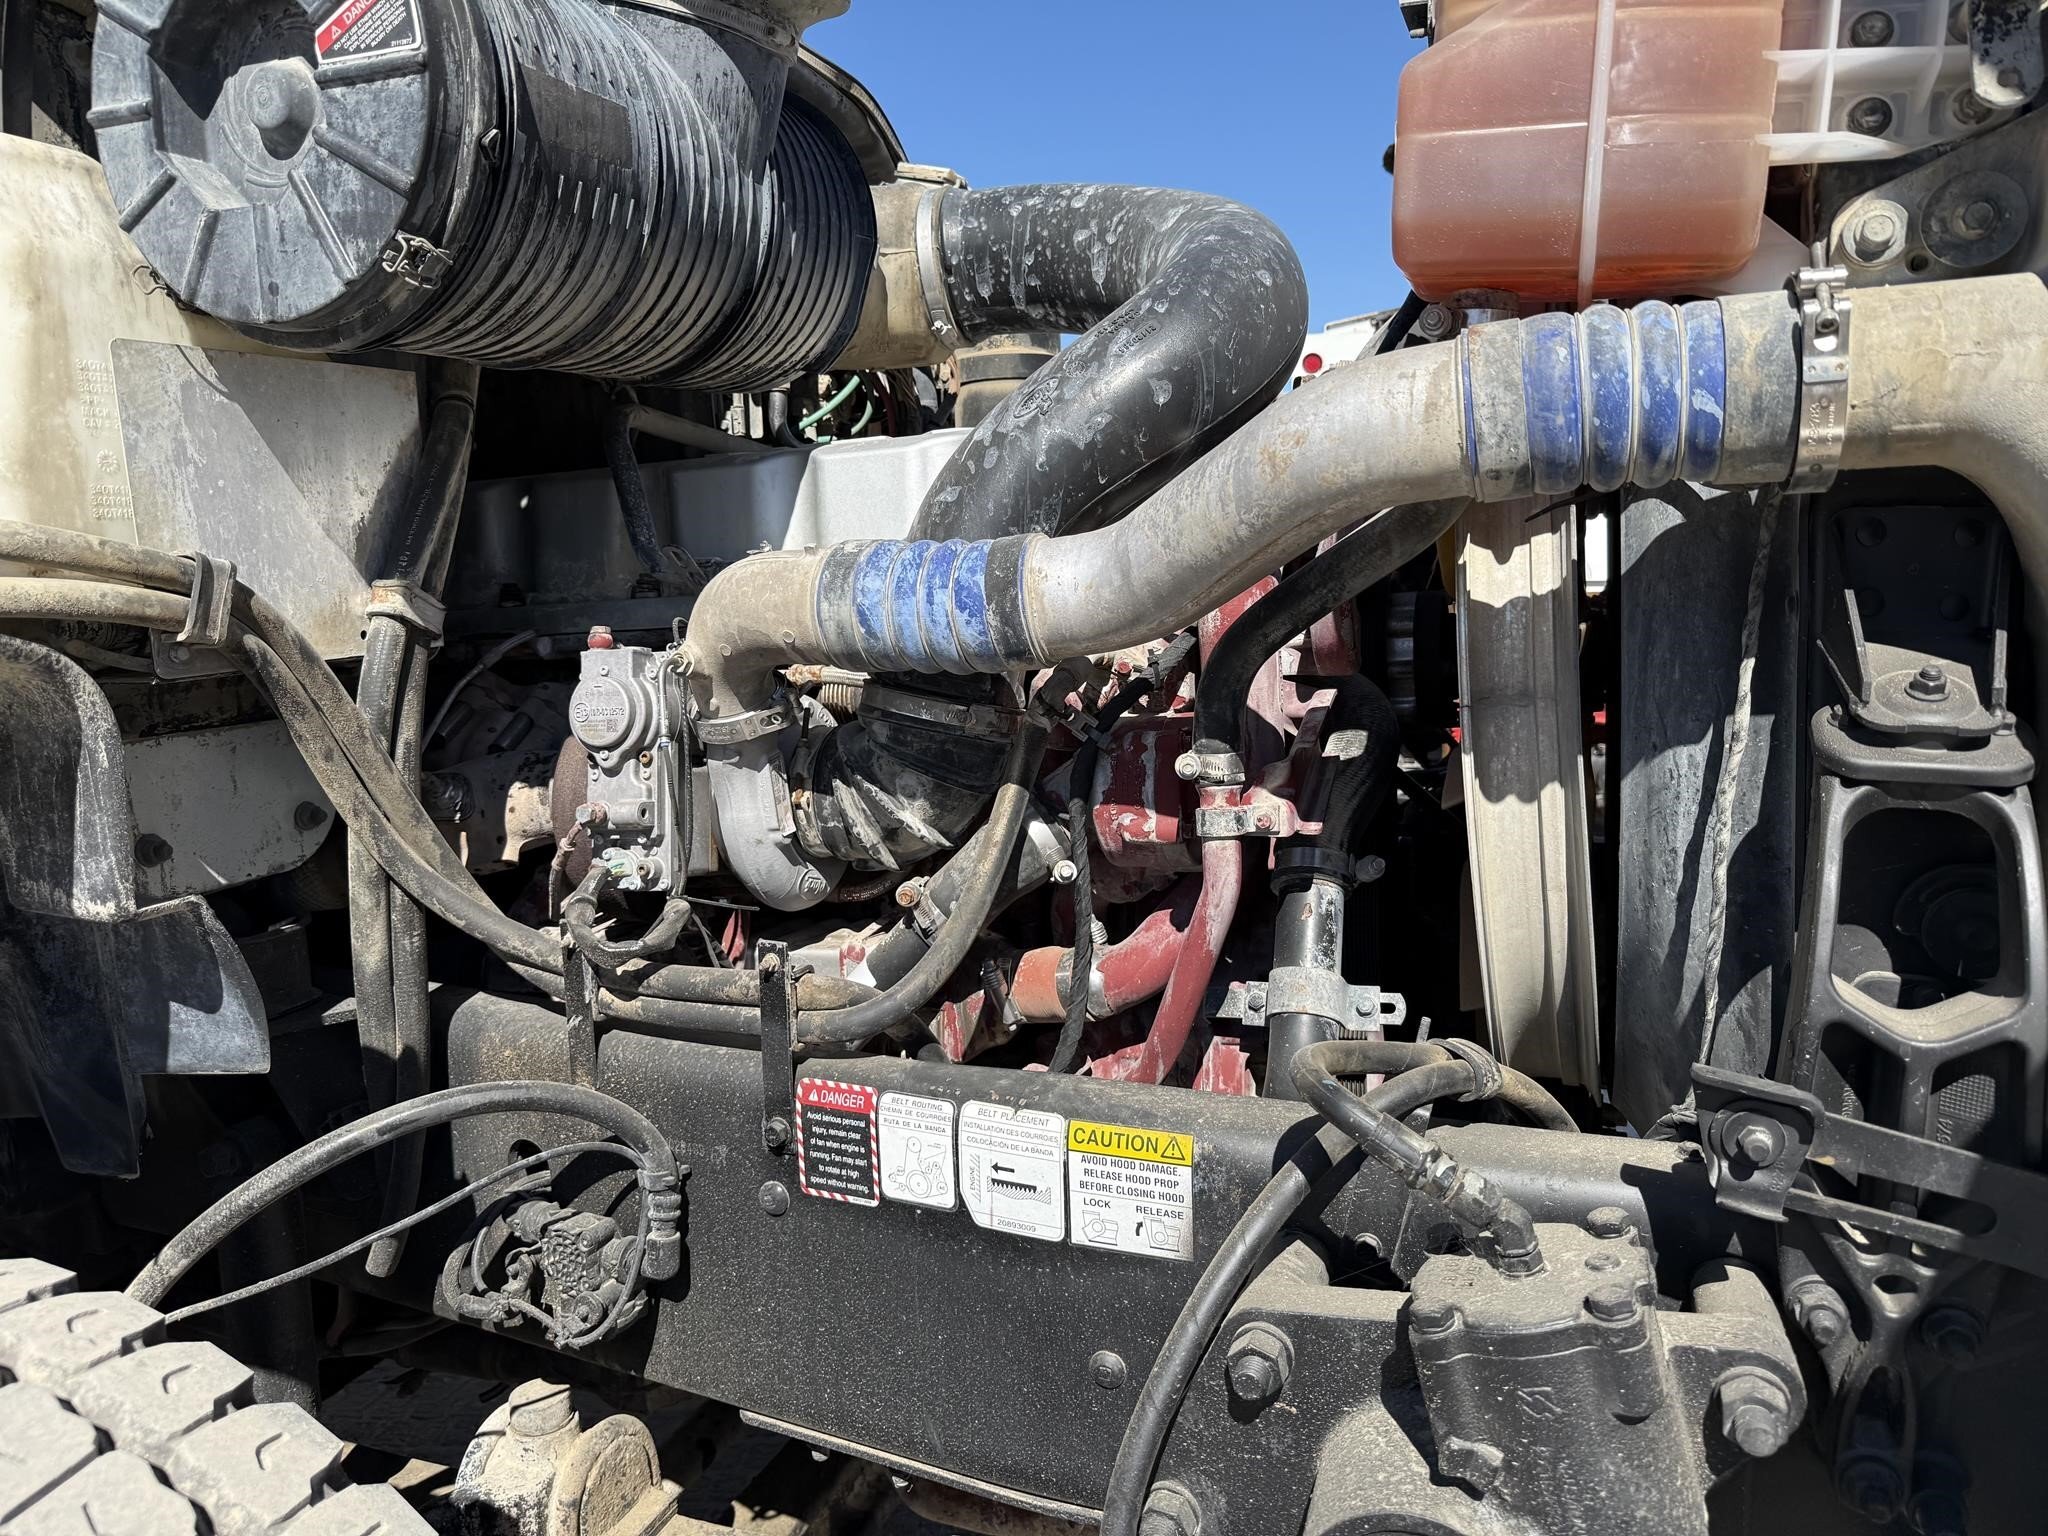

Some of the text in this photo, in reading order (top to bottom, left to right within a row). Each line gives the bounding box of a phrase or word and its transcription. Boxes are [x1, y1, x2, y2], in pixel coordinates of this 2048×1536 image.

[344, 35, 358, 49] CAUSE
[358, 20, 373, 35] ENGINE
[373, 5, 390, 22] DAMAGE
[365, 27, 383, 44] SERIOUS
[383, 6, 405, 28] PERSONAL
[371, 11, 406, 48] INJURY OR DEATH
[334, 43, 341, 51] DO
[341, 33, 350, 44] NOT
[350, 26, 359, 35] USE
[820, 1090, 864, 1108] DANGER
[891, 1097, 943, 1111] BELT ROUTING
[880, 1106, 902, 1114] CHEMIN
[978, 1109, 1050, 1127] BELT PLACEMENT
[806, 1111, 865, 1127] Avoid serious personal
[812, 1125, 861, 1140] injury, remain clear
[924, 1124, 946, 1133] BANDA
[964, 1121, 1059, 1144] INSTALLATION DES COURROIES
[810, 1137, 816, 1145] of
[816, 1138, 825, 1146] fan
[826, 1141, 840, 1149] when
[841, 1143, 859, 1153] engine
[1073, 1127, 1159, 1154] CAUTION
[809, 1150, 867, 1167] running. Fan may start
[1010, 1143, 1020, 1151] DE
[1021, 1144, 1030, 1152] LA
[1031, 1146, 1054, 1157] BANDA
[825, 1166, 840, 1174] rotate
[848, 1169, 860, 1178] high
[1080, 1154, 1181, 1177] AVOID HOOD DAMAGE.
[810, 1176, 869, 1193] speed without warning.
[1084, 1168, 1179, 1189] RELEASE HOOD PROP
[1079, 1180, 1184, 1204] BEFORE CLOSING HOOD
[1083, 1197, 1111, 1209] LOCK
[1136, 1205, 1184, 1220] RELEASE
[997, 1219, 1037, 1233] 20893009
